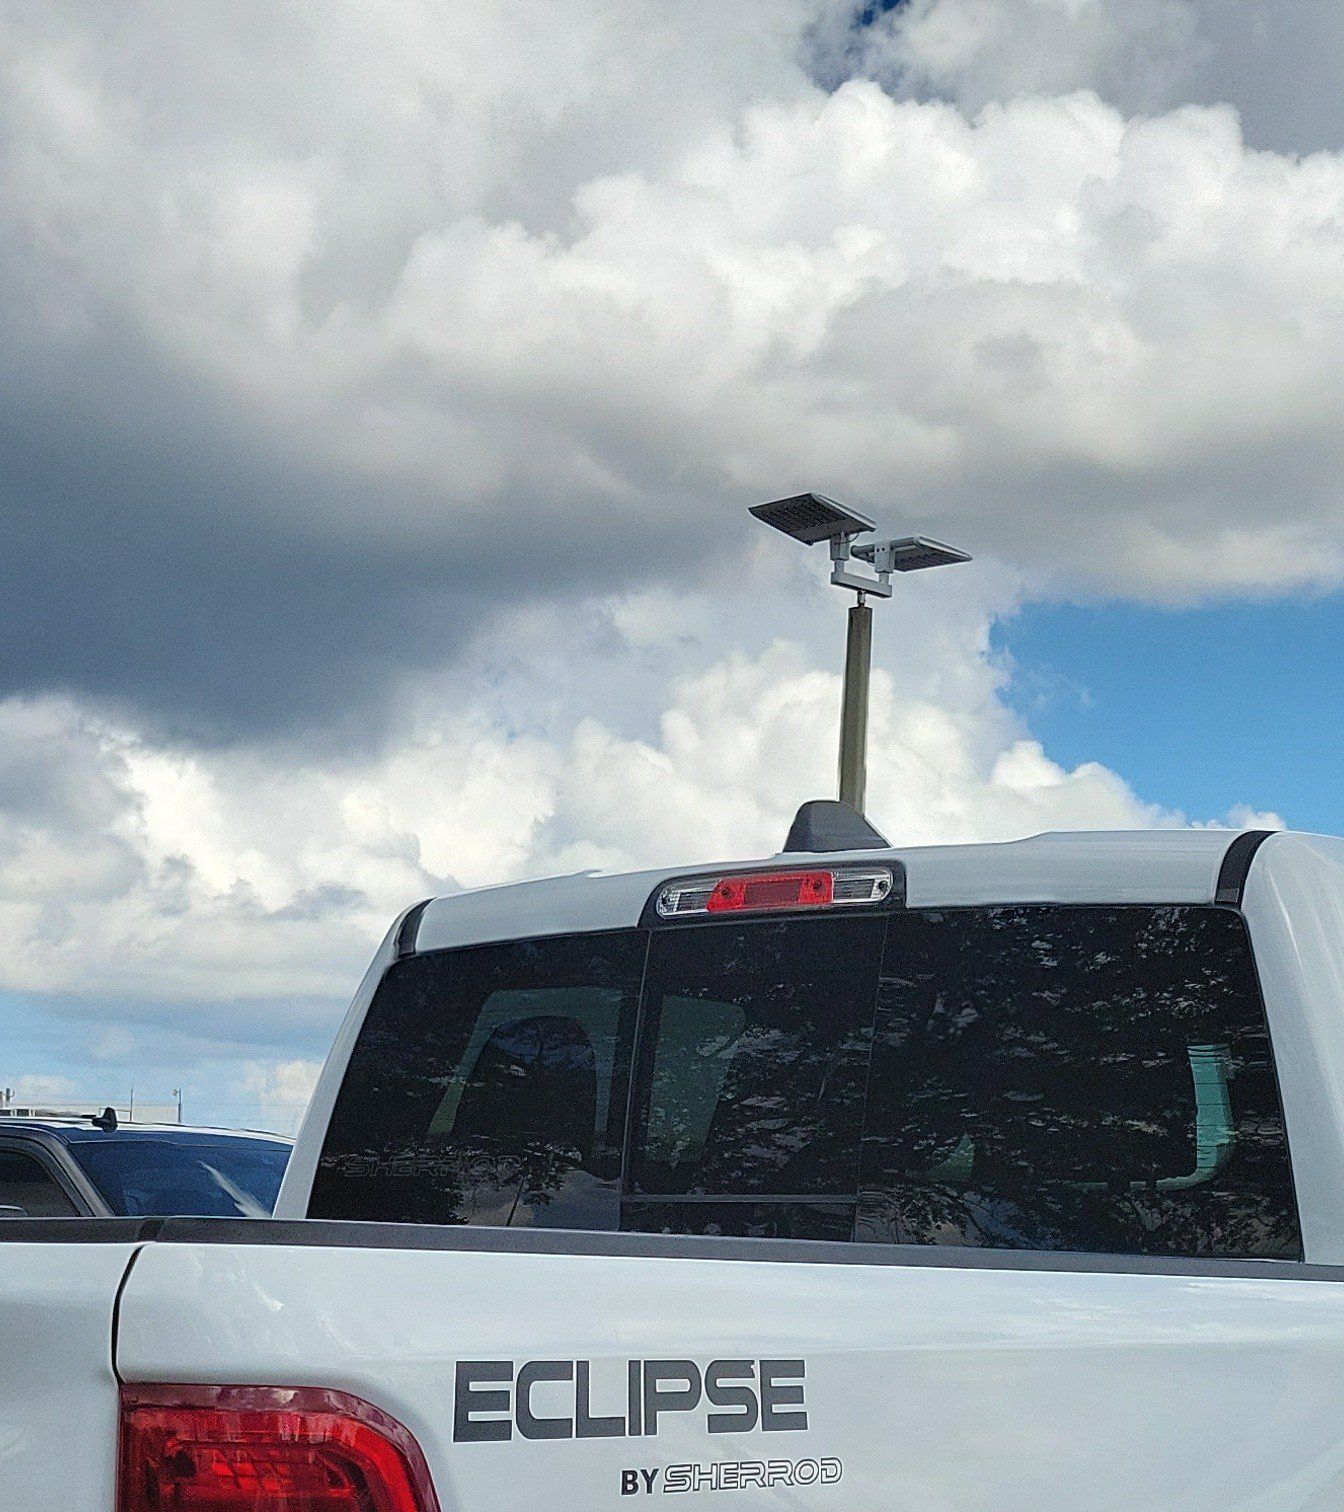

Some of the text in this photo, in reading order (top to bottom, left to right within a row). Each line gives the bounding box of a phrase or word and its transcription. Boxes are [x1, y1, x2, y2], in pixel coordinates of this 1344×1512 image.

[452, 1359, 808, 1443] ECLIPSE
[621, 1456, 843, 1495] BY SHERROD
